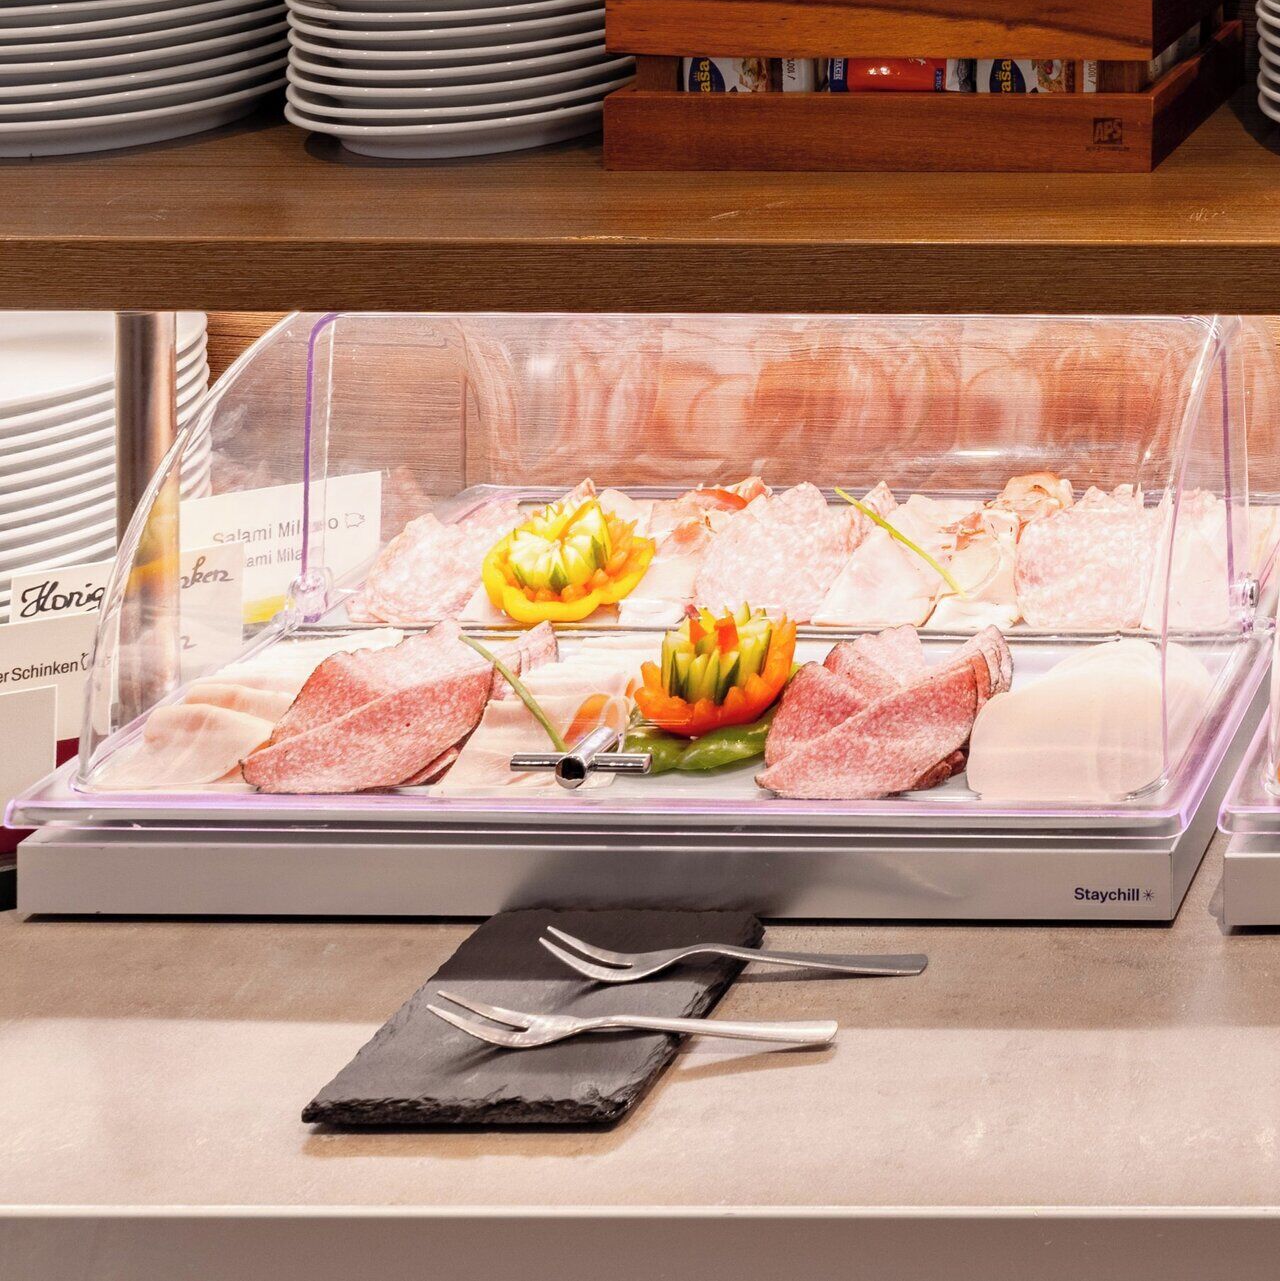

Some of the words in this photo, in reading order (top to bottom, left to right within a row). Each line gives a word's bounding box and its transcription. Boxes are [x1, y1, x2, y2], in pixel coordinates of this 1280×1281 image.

[700, 60, 710, 92] asa
[1001, 60, 1011, 93] asa
[278, 517, 338, 539] Milo
[12, 659, 78, 681] Schinken
[1074, 888, 1139, 903] Staychill
